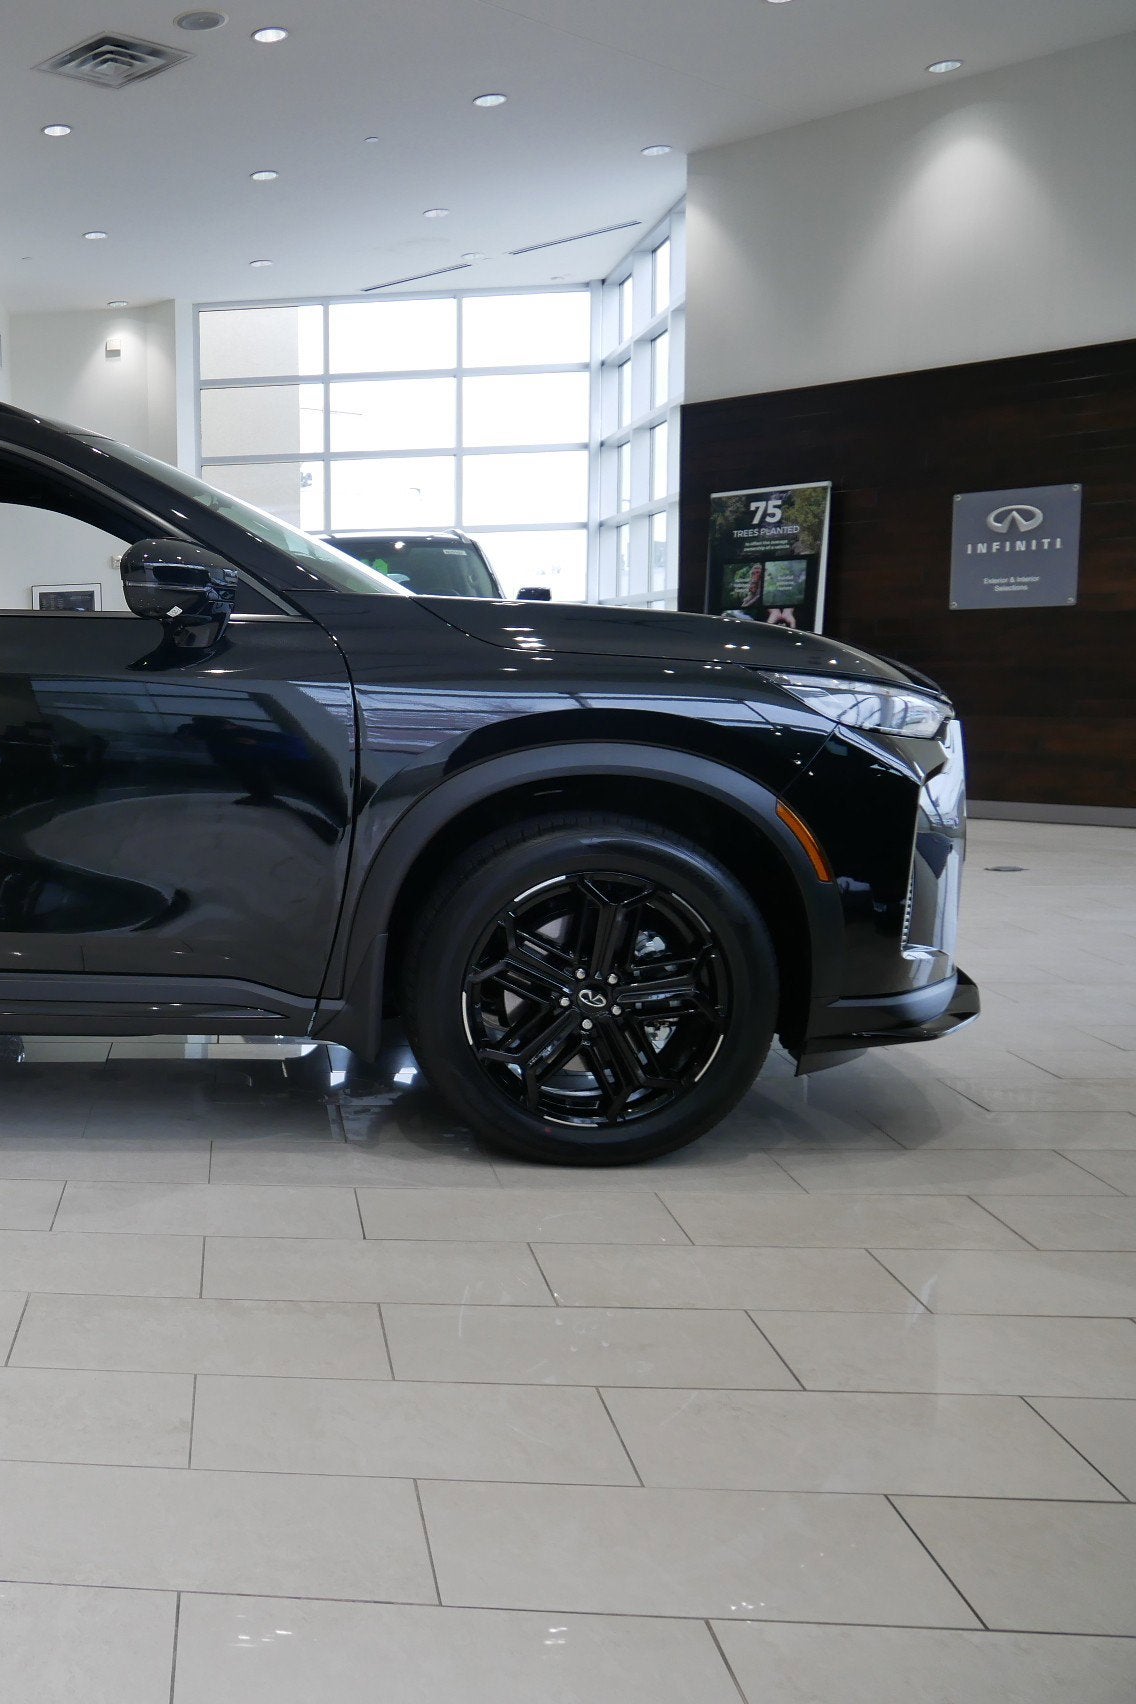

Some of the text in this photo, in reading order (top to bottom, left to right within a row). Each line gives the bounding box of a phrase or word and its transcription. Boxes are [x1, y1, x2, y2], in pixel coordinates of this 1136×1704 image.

[750, 500, 782, 524] 75
[733, 525, 800, 538] TREES PLANTED
[966, 538, 1063, 554] INFINITI
[1016, 575, 1040, 583] Interior
[994, 584, 1028, 592] Selections
